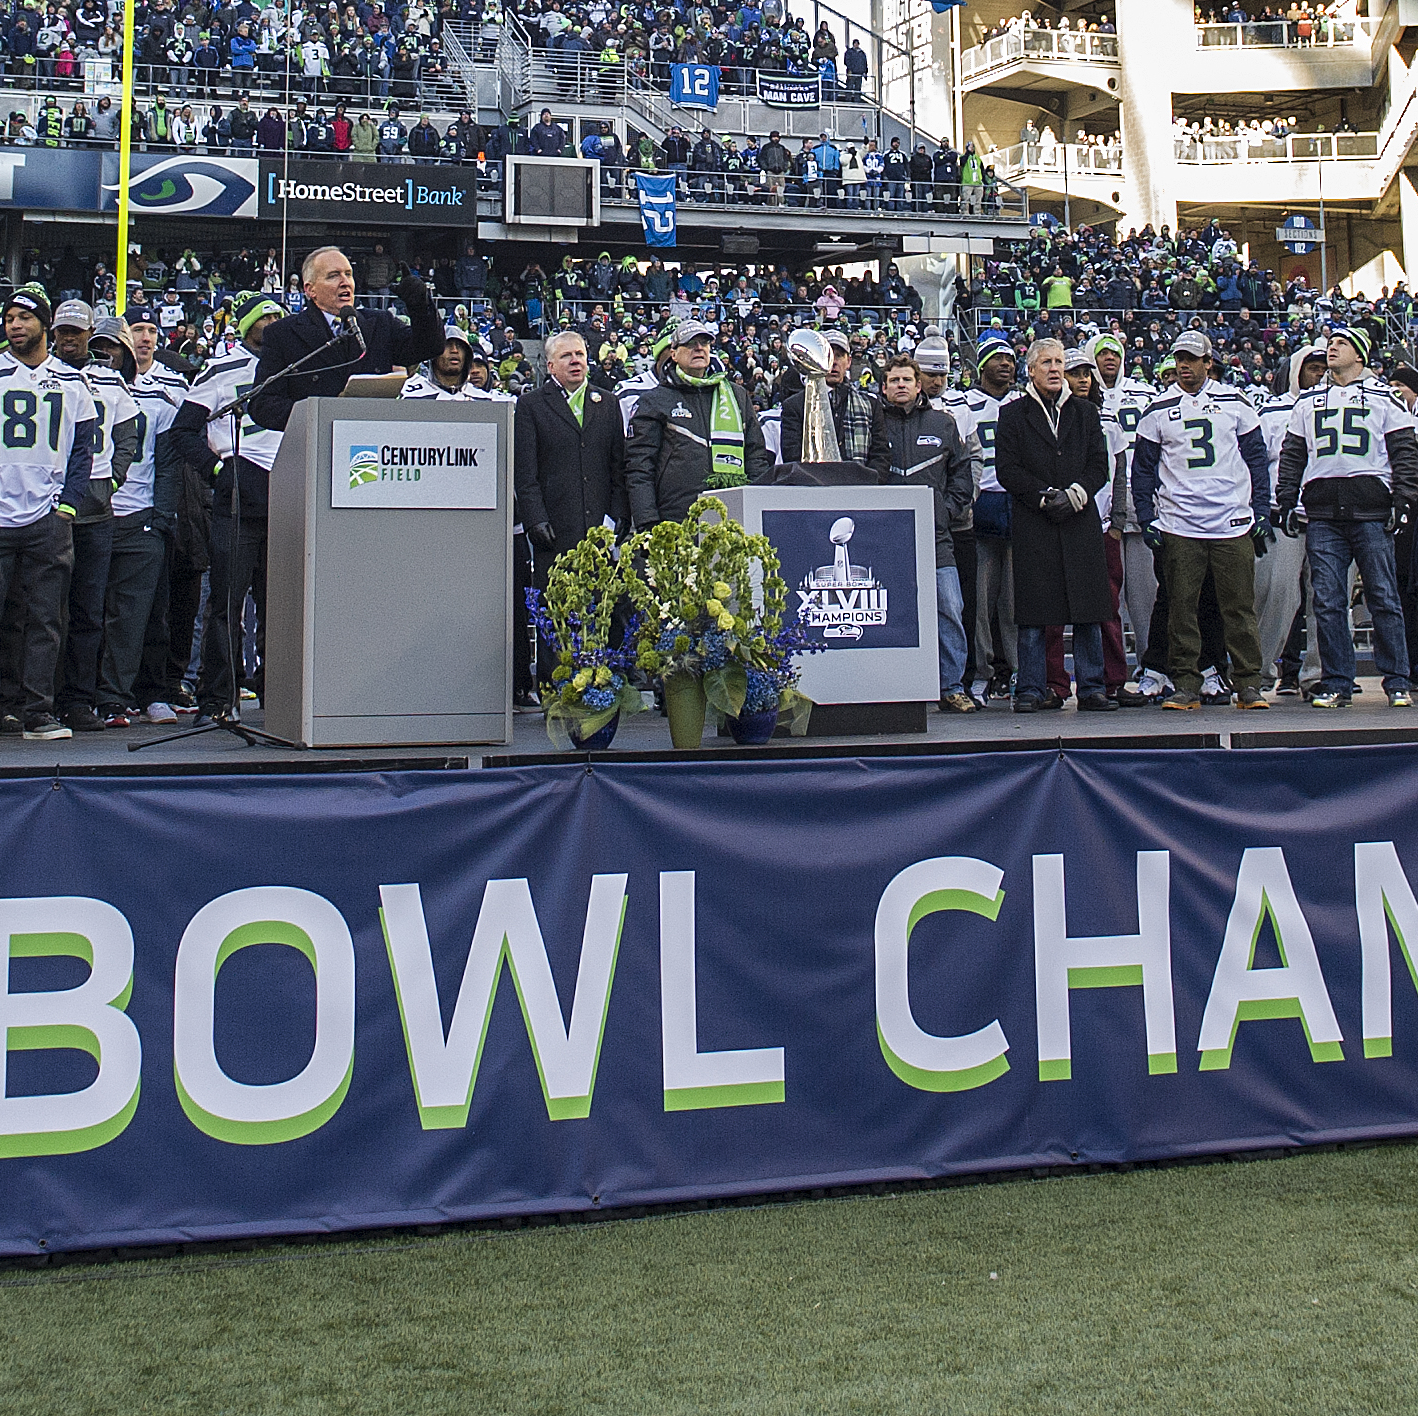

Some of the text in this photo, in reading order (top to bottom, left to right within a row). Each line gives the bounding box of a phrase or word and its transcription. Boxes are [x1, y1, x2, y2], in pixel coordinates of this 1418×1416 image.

[312, 49, 319, 60] 3
[681, 69, 709, 95] 12
[763, 90, 816, 104] MAN CAVE
[317, 126, 326, 139] 3
[382, 126, 399, 140] 59
[889, 152, 904, 164] 24
[415, 186, 465, 207] Bank
[639, 190, 676, 234] 12
[1284, 228, 1318, 239] SECTIONS
[2, 388, 65, 453] 81
[1313, 407, 1372, 460] 55
[1183, 418, 1217, 470] 3
[381, 445, 478, 466] CENTURYLINK
[381, 468, 421, 482] FIELD
[795, 589, 888, 613] XLVIII
[811, 611, 883, 624] HAMPIONS
